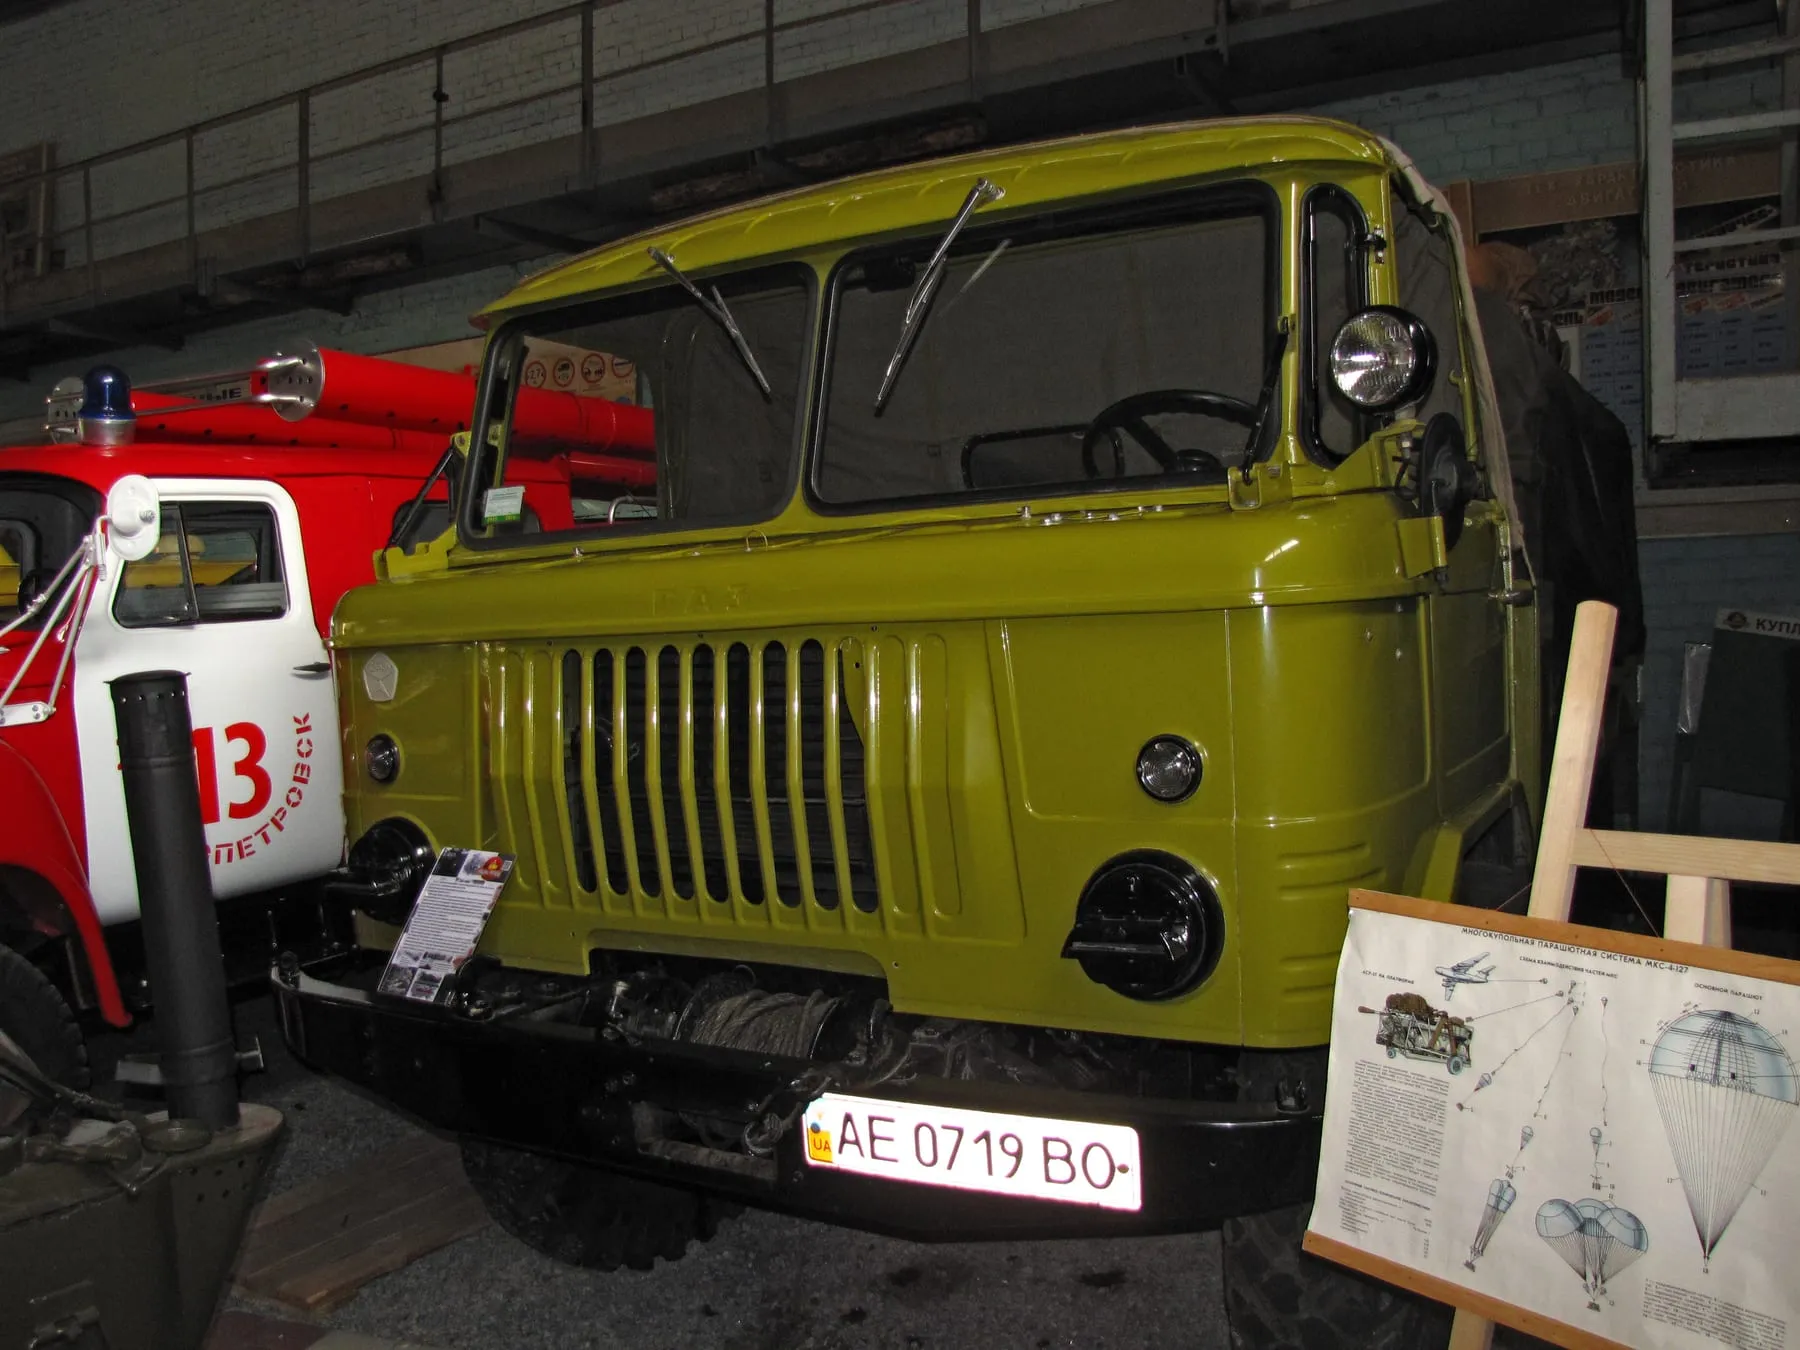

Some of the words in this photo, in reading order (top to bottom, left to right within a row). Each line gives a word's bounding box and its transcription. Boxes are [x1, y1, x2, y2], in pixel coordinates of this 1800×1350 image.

[205, 712, 313, 865] ПЕТРОВСК
[1461, 926, 1535, 946] МНОГОКУПОЛЬНАЯ
[1538, 941, 1597, 957] ПАРАШЮТНАЯ
[1600, 951, 1642, 966] СИСТЕМА
[1645, 960, 1689, 974] МКС-4-127
[1694, 982, 1728, 994] ОСНОВНОЙ
[1730, 990, 1763, 1001] ПАРАШЮТ
[813, 1138, 831, 1153] UA
[838, 1111, 899, 1163] AE
[914, 1122, 1023, 1179] 0719
